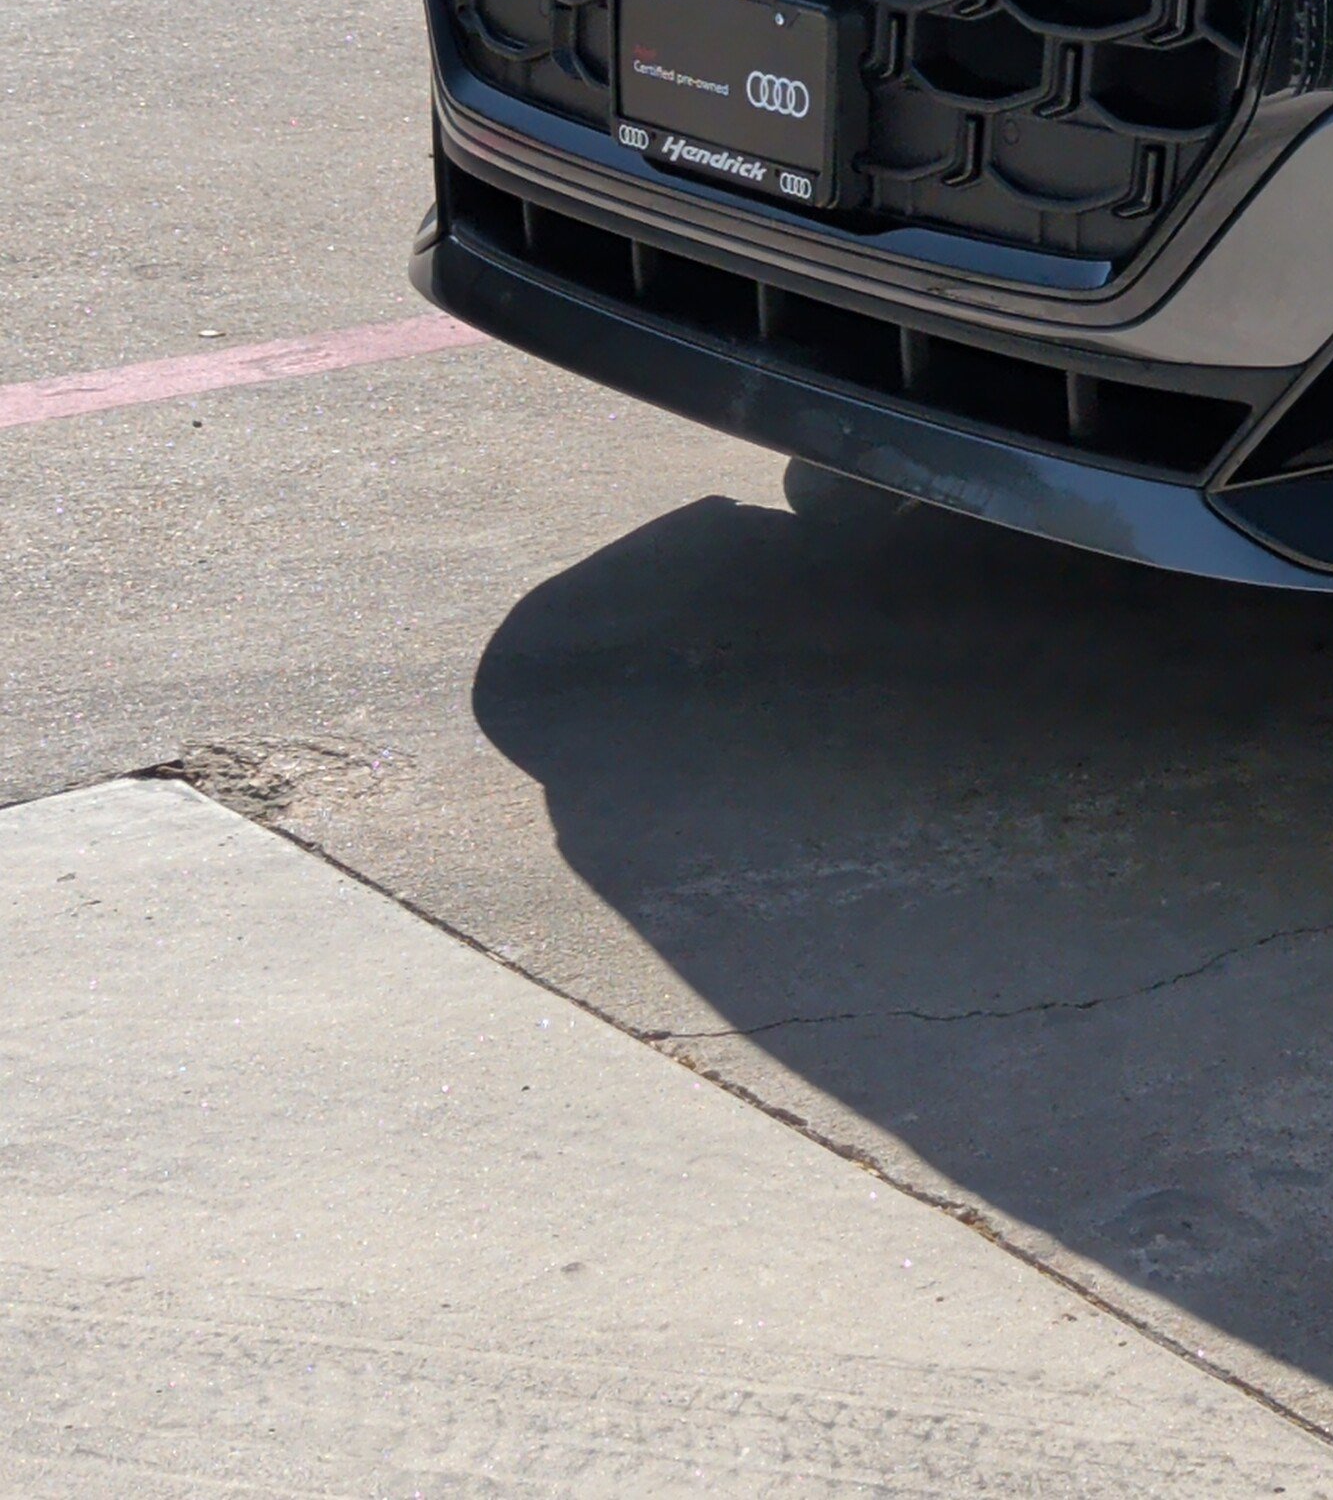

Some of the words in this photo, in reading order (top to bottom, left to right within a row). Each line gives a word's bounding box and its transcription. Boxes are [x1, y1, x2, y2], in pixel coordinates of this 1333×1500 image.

[634, 59, 675, 81] Certified
[676, 73, 730, 96] pre-owned
[661, 136, 767, 181] Hendrick
